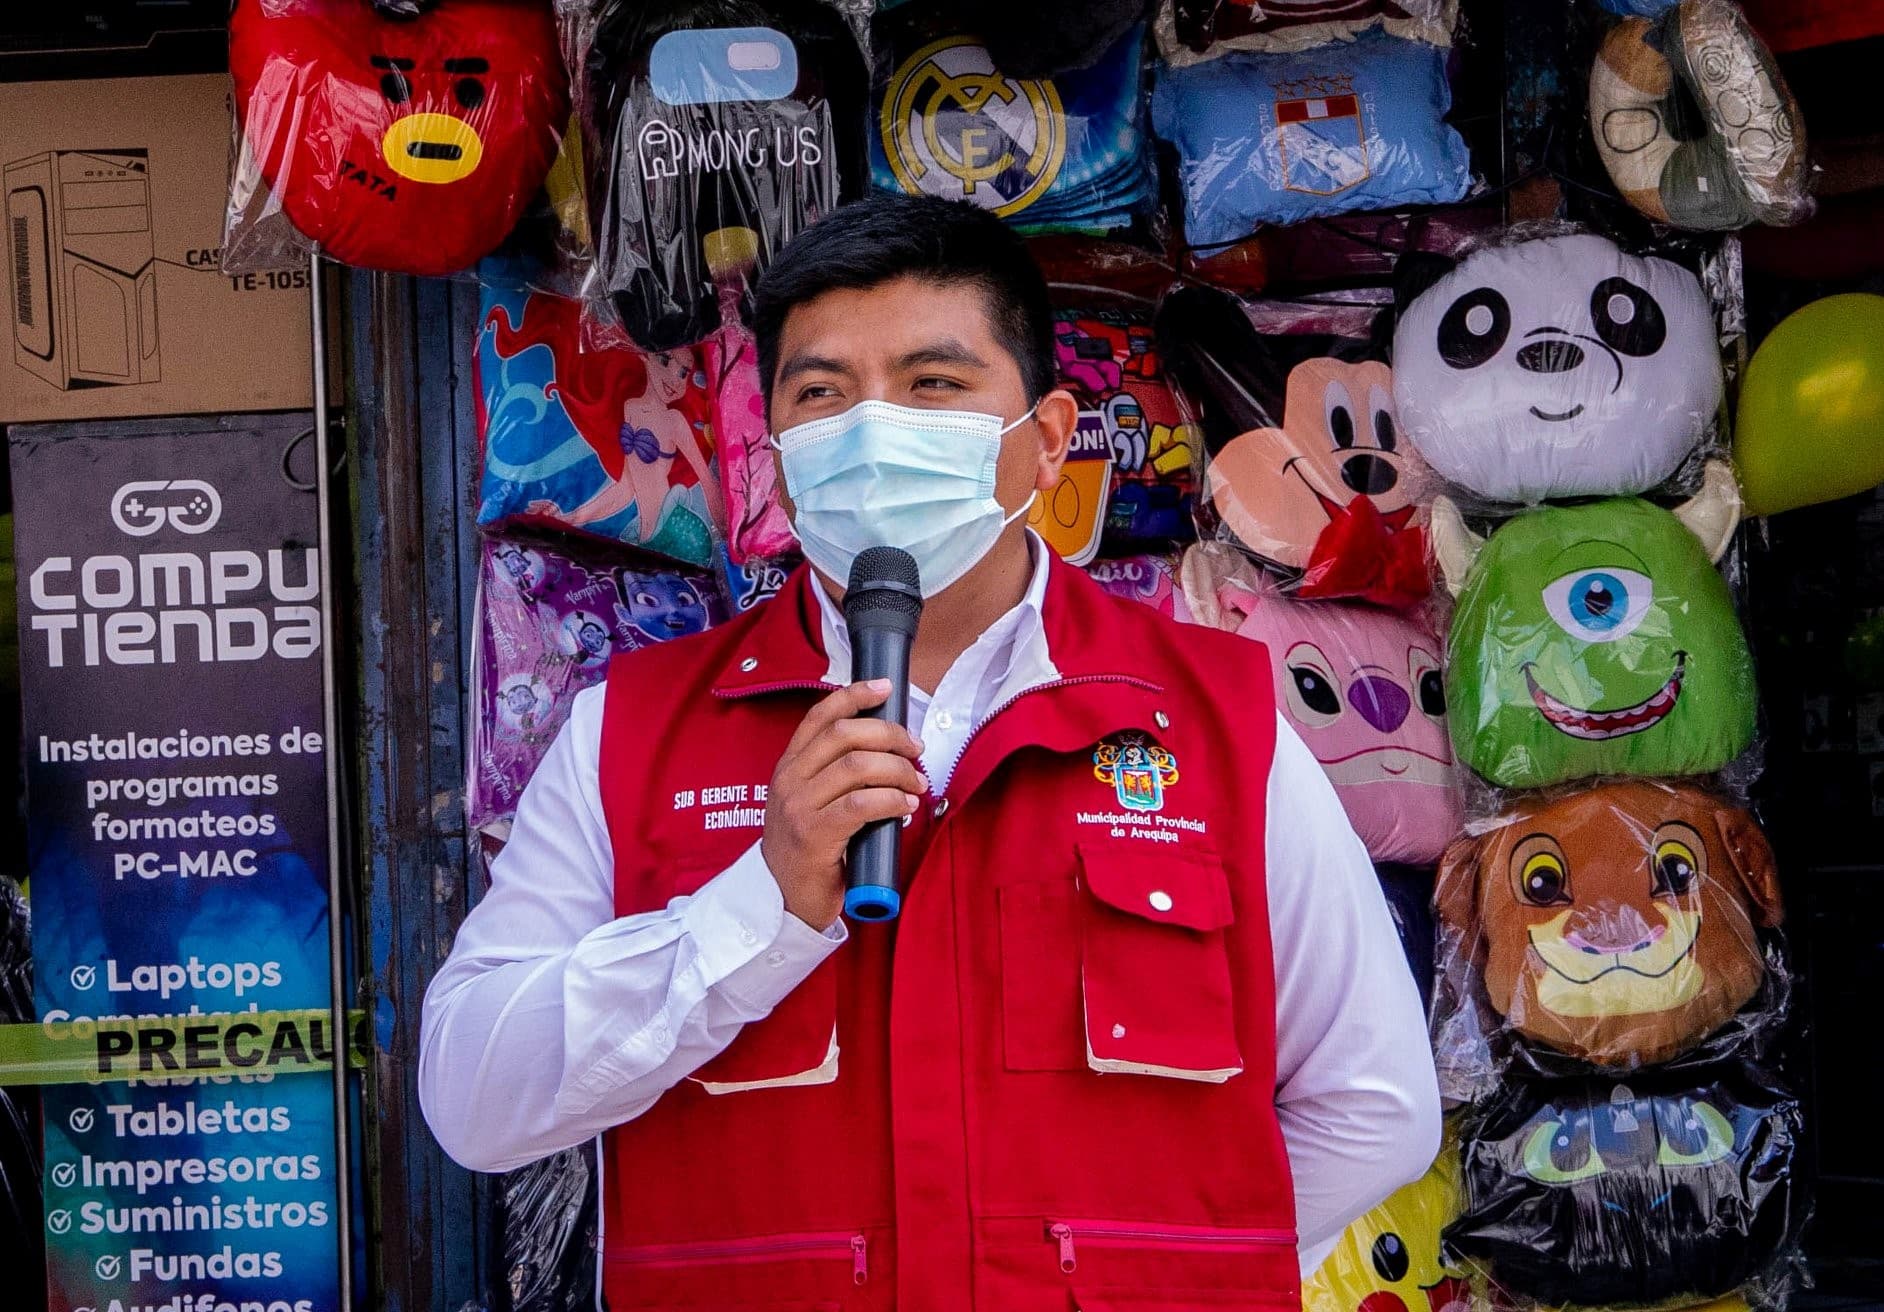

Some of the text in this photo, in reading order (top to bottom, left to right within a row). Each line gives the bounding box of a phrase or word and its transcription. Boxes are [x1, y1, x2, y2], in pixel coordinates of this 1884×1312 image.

[777, 126, 821, 166] US
[341, 160, 396, 202] TATA
[186, 248, 225, 266] CAS
[1068, 429, 1105, 452] ON!
[40, 726, 323, 763] Instalaciones de
[87, 773, 279, 808] programas
[673, 790, 695, 810] SUB
[701, 785, 748, 806] GERENTE
[92, 810, 276, 842] formateos
[1076, 811, 1206, 833] Municipalidad Provincial
[1111, 827, 1179, 843] de Arequipa
[115, 849, 258, 880] PC-MAC
[107, 957, 282, 999] Laptops
[107, 1101, 291, 1137] Tabletas
[82, 1154, 321, 1194] Impresoras
[80, 1196, 328, 1235] Suministros
[130, 1246, 283, 1282] Fundas
